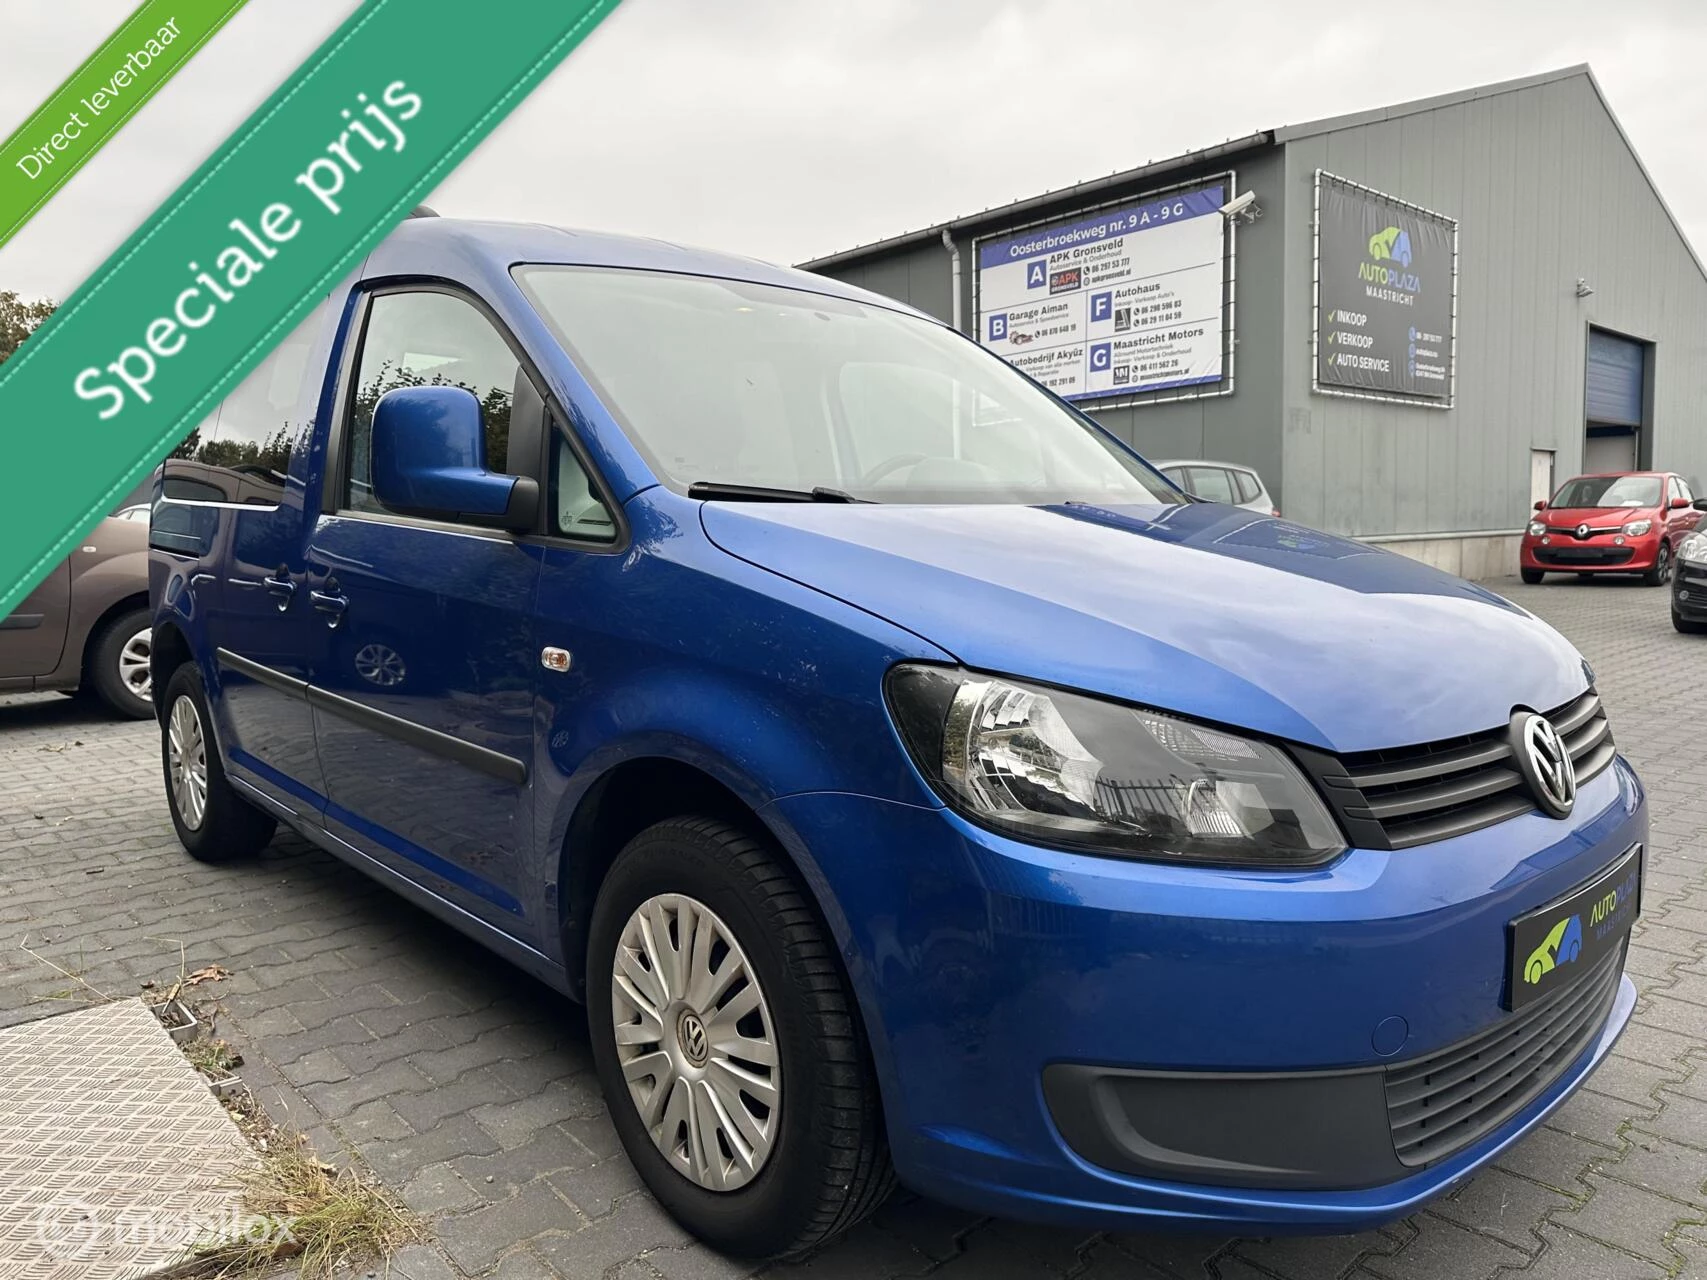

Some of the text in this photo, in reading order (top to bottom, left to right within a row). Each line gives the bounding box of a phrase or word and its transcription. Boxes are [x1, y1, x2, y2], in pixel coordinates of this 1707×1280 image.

[1010, 223, 1106, 257] Oosterbroekweg
[1110, 217, 1126, 233] nr.
[1130, 213, 1137, 226] 9
[1140, 211, 1150, 224] A
[1161, 206, 1169, 219] 9
[1173, 203, 1184, 216] G
[1050, 238, 1123, 264] APK Gronsveld
[1050, 261, 1081, 271] Autoservice
[1090, 250, 1122, 262] Onderhoud
[1030, 266, 1043, 284] A
[1058, 272, 1079, 284] APK
[1358, 262, 1421, 292] AUTOPLAZA
[1115, 283, 1160, 298] Autohaus
[1366, 286, 1413, 306] MAASTRICHT
[1009, 303, 1068, 321] Garage Aiman
[1096, 298, 1106, 316] F
[1337, 310, 1367, 327] INKOOP
[993, 320, 1004, 336] B
[1114, 328, 1204, 350] Maastricht Motors
[1337, 332, 1373, 349] VERKOOP
[1093, 349, 1106, 366] G
[1337, 353, 1390, 372] AUTO SERVICE
